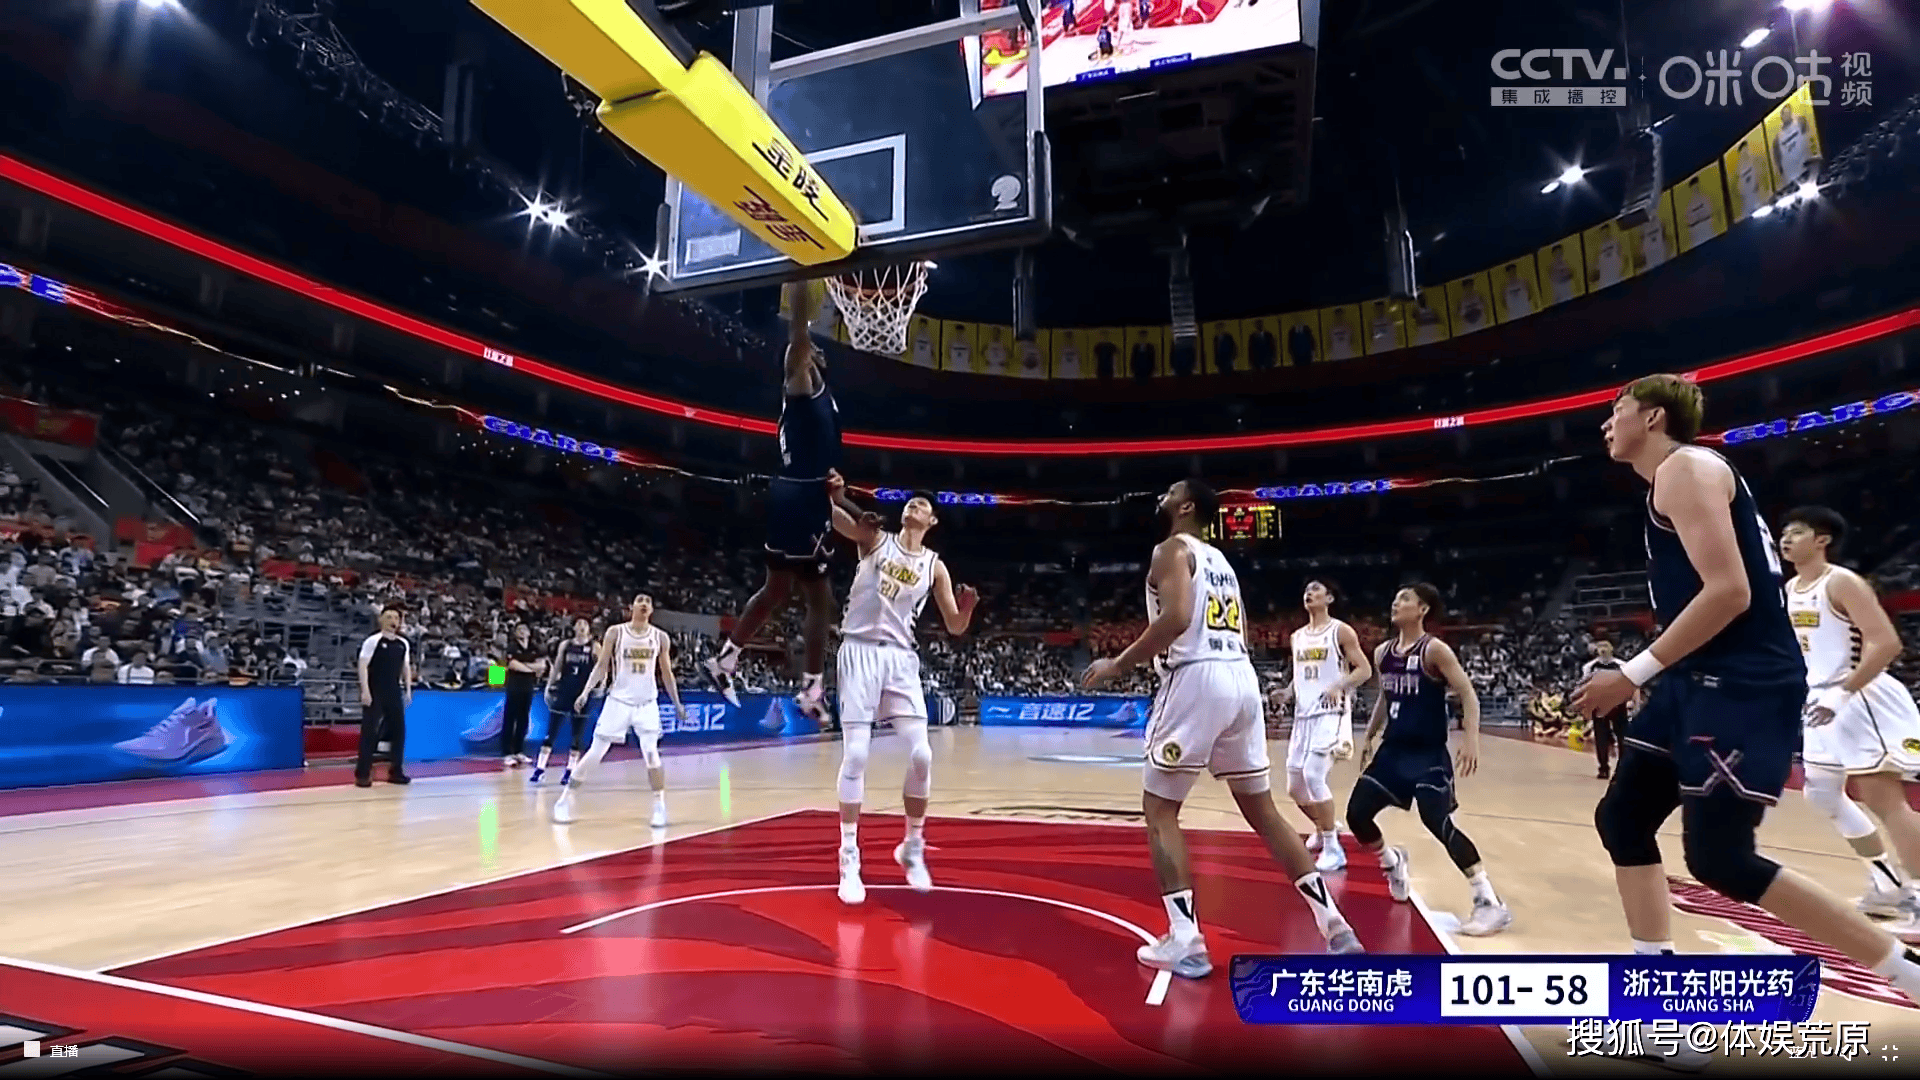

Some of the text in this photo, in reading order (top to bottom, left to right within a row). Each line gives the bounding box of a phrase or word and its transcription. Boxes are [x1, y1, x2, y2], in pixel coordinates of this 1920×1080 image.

[483, 415, 620, 462] CHARGE
[1253, 478, 1394, 499] CHARGE
[1206, 592, 1241, 633] 22
